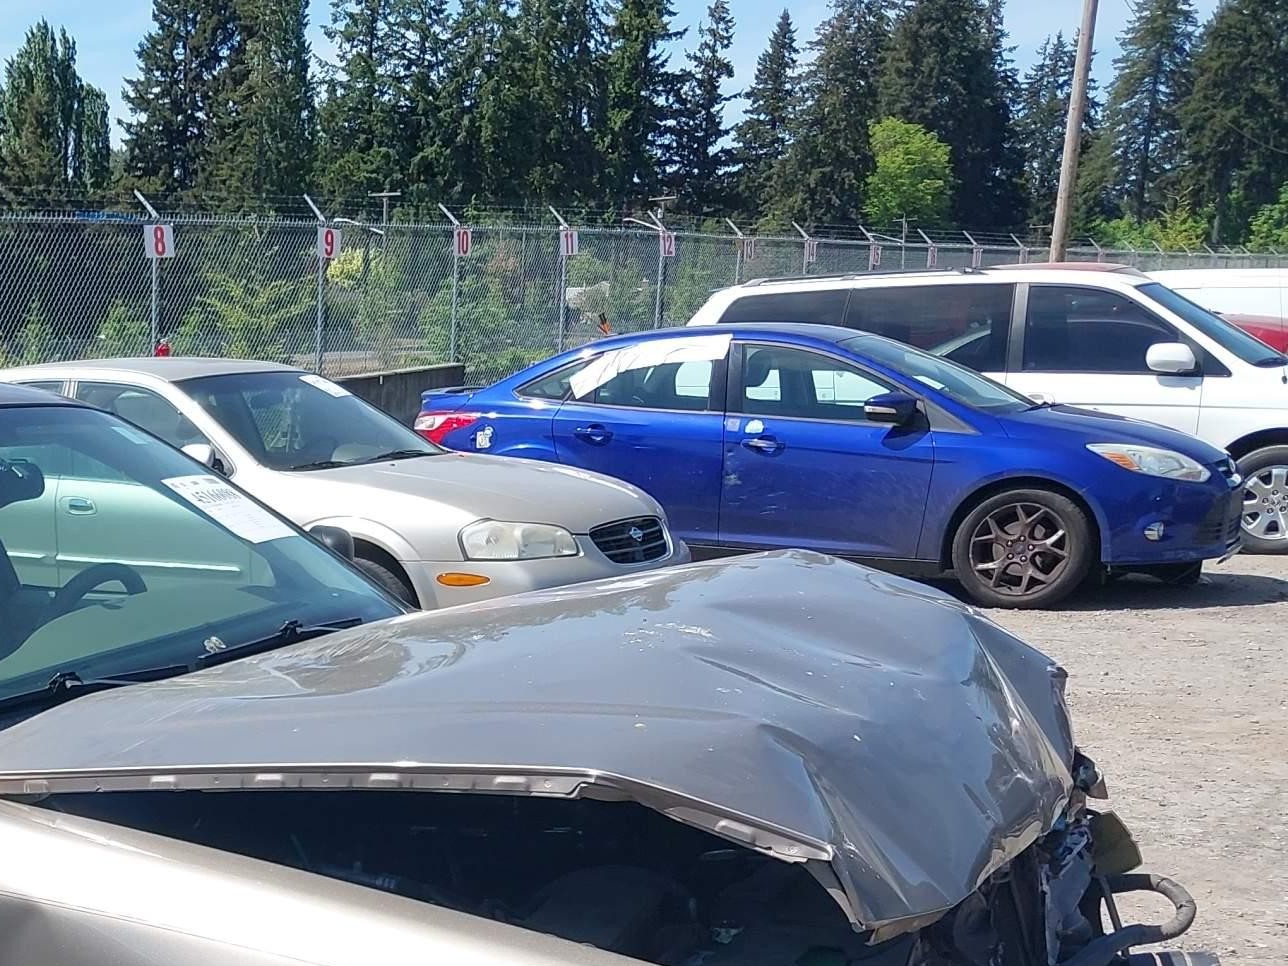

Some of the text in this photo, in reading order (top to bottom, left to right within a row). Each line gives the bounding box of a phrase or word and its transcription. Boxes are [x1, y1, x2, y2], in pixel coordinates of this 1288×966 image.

[152, 227, 167, 256] 8
[323, 229, 335, 257] 9
[456, 230, 469, 255] 10
[564, 233, 575, 254] 11
[662, 235, 673, 256] 12
